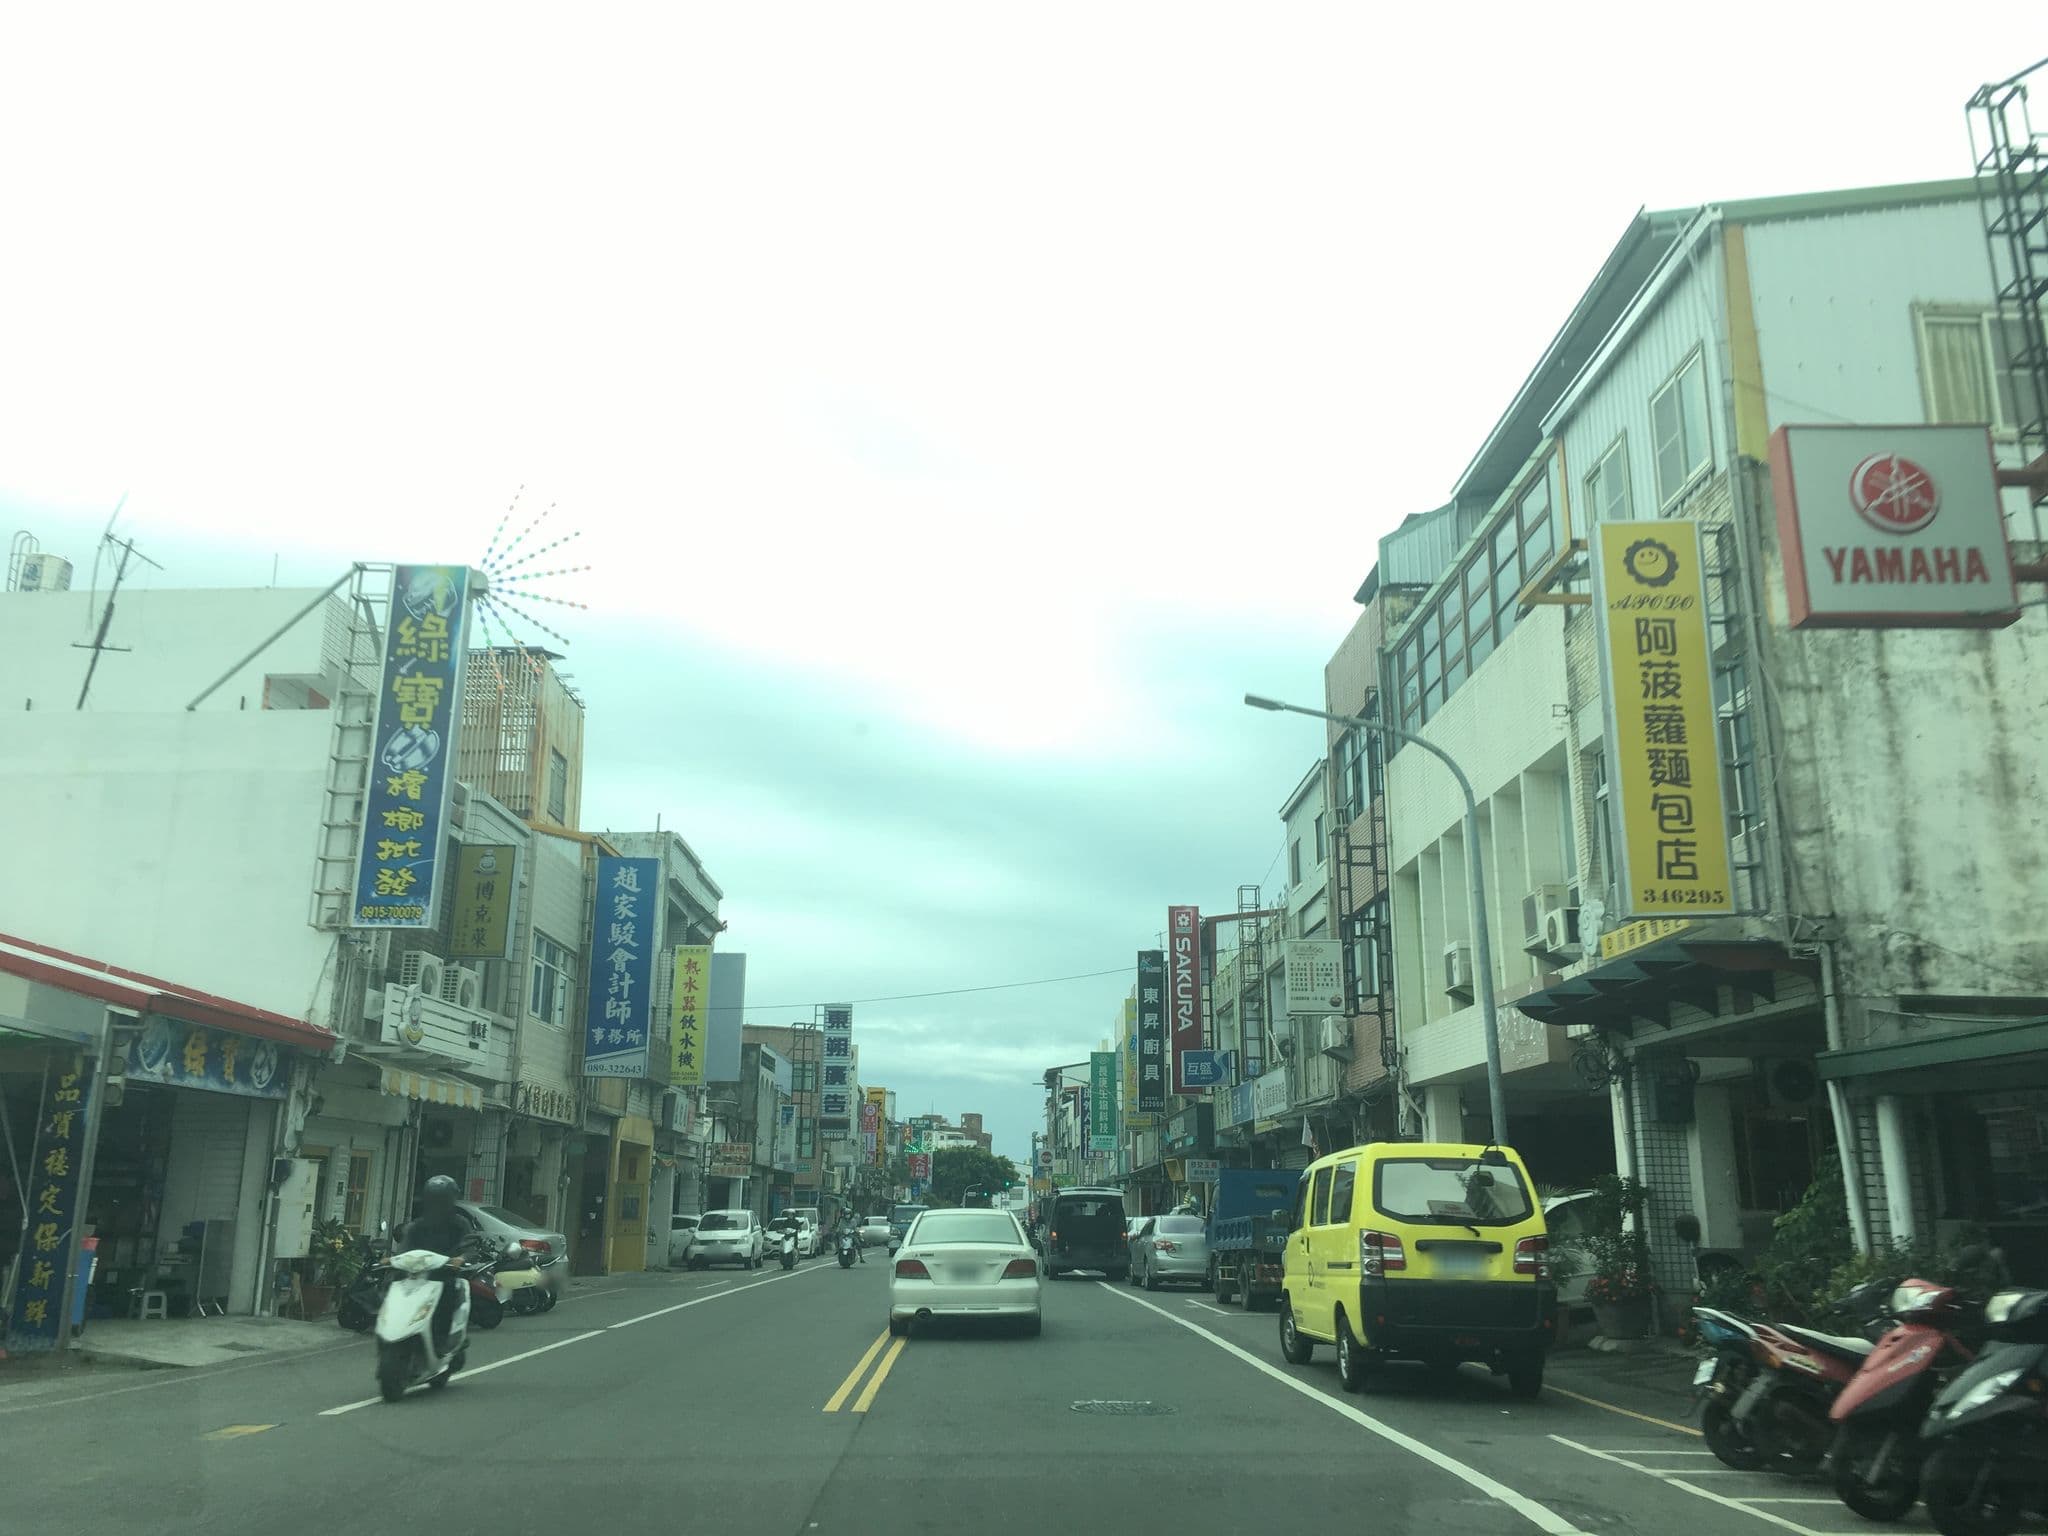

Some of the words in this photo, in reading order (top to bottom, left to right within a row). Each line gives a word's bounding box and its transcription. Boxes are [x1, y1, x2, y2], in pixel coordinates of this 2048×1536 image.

[1823, 547, 1990, 584] YAMAHA
[1635, 617, 1699, 881] 阿菠蘿麵包店
[375, 769, 428, 896] 檳榔批發
[361, 906, 423, 920] 0915-700079
[1643, 888, 1724, 905] 346295
[606, 866, 642, 1025] 趙家駿會計師
[1175, 937, 1193, 1032] SAKURA
[592, 1026, 643, 1045] 事務所
[1143, 988, 1160, 1081] 東昇廚具
[587, 1063, 642, 1075] 089-322643
